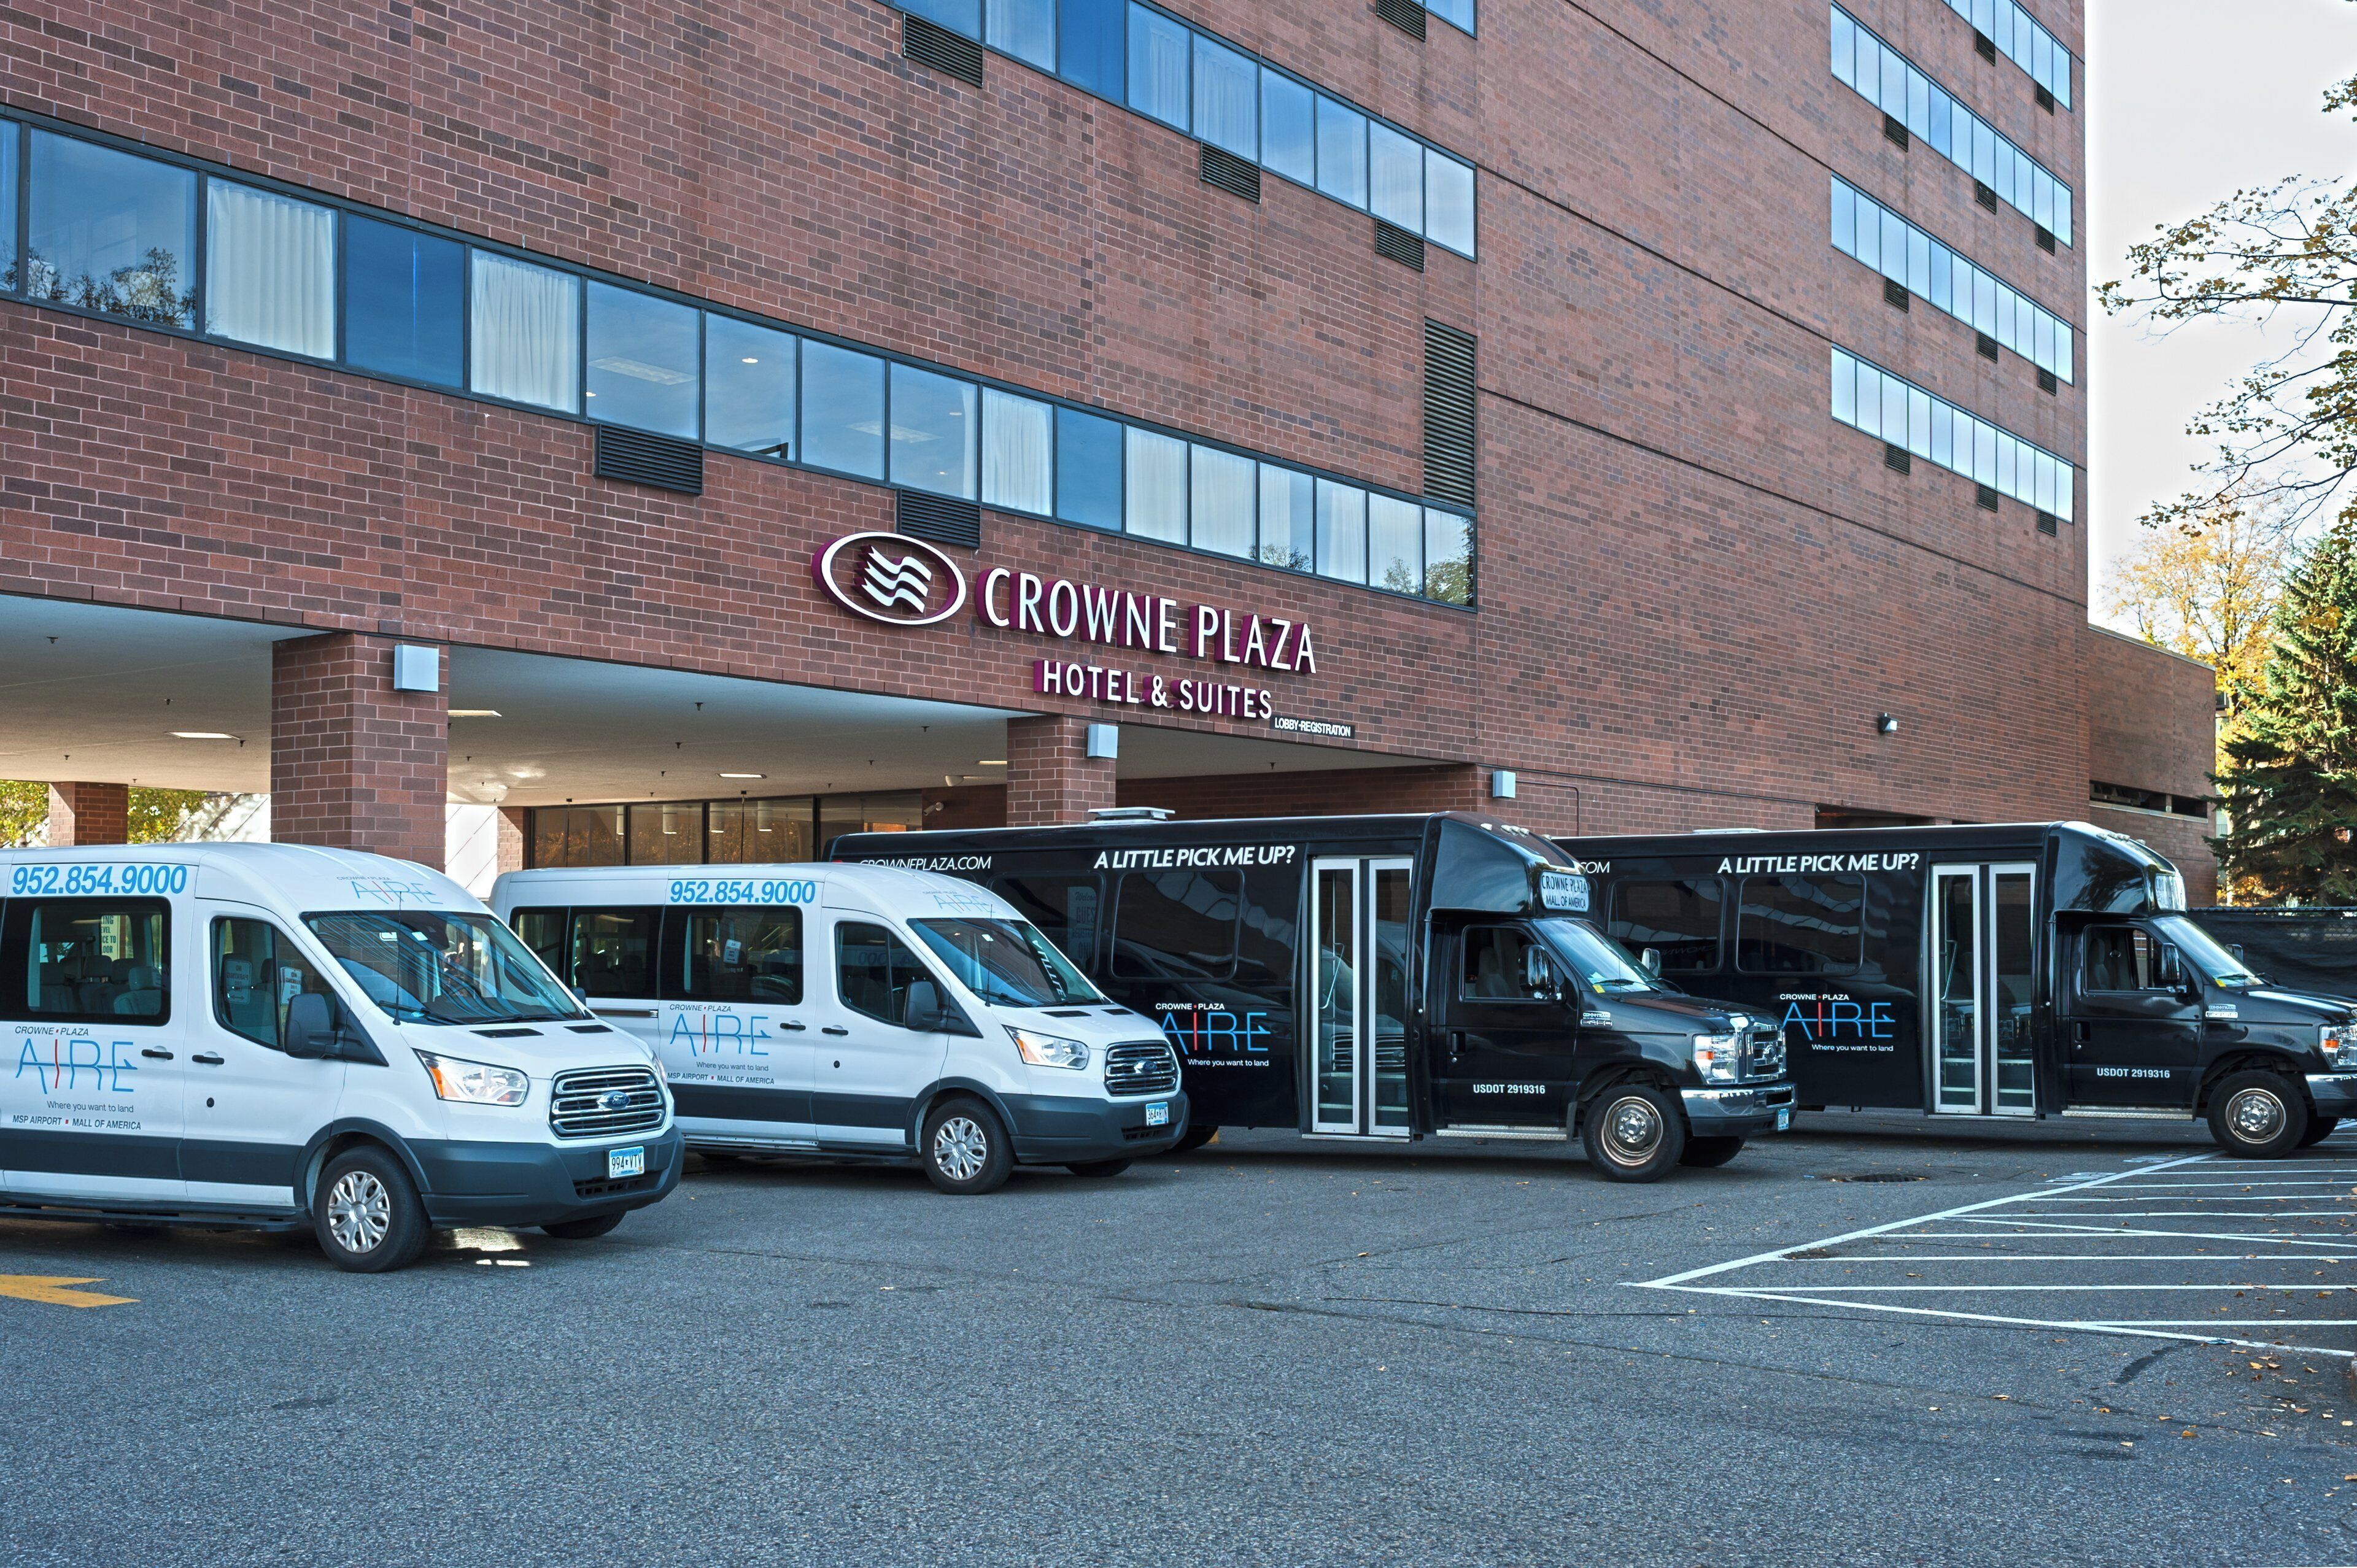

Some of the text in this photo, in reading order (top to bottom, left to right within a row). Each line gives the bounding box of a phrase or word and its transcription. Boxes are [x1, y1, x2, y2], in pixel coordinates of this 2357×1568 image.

[976, 567, 1317, 674] CROWNE PLAZA
[1034, 659, 1272, 719] HOTEL & SUITES
[1274, 716, 1352, 737] LOBBY-REGISTRATION
[1094, 845, 1296, 869] A LITTLE PICK ME UP?
[1717, 852, 1920, 874] A LITTLE PICK ME UP?
[12, 865, 187, 895] 952.854.9000
[1541, 875, 1587, 894] CROWNE PLAZA
[670, 881, 816, 903] 952.854.9000
[1546, 895, 1587, 908] MALL OF AMERICA
[101, 915, 114, 925] ING
[103, 945, 114, 954] OOR
[15, 1025, 89, 1036] CROWNE PLAZA
[1781, 1002, 1896, 1041] AIRE
[670, 1013, 772, 1057] AIRE
[1161, 1011, 1272, 1055] AIRE
[15, 1038, 138, 1095] AIRE
[2096, 1067, 2170, 1078] USDOT 2919316
[1473, 1083, 1546, 1094] USDOT 2919316
[47, 1100, 72, 1110] Where
[72, 1103, 87, 1112] you
[108, 1104, 117, 1113] to
[117, 1104, 134, 1113] land
[12, 1114, 142, 1130] MSP AIRPORT MALL OF AMERICA
[611, 1153, 642, 1170] 994 VTV
